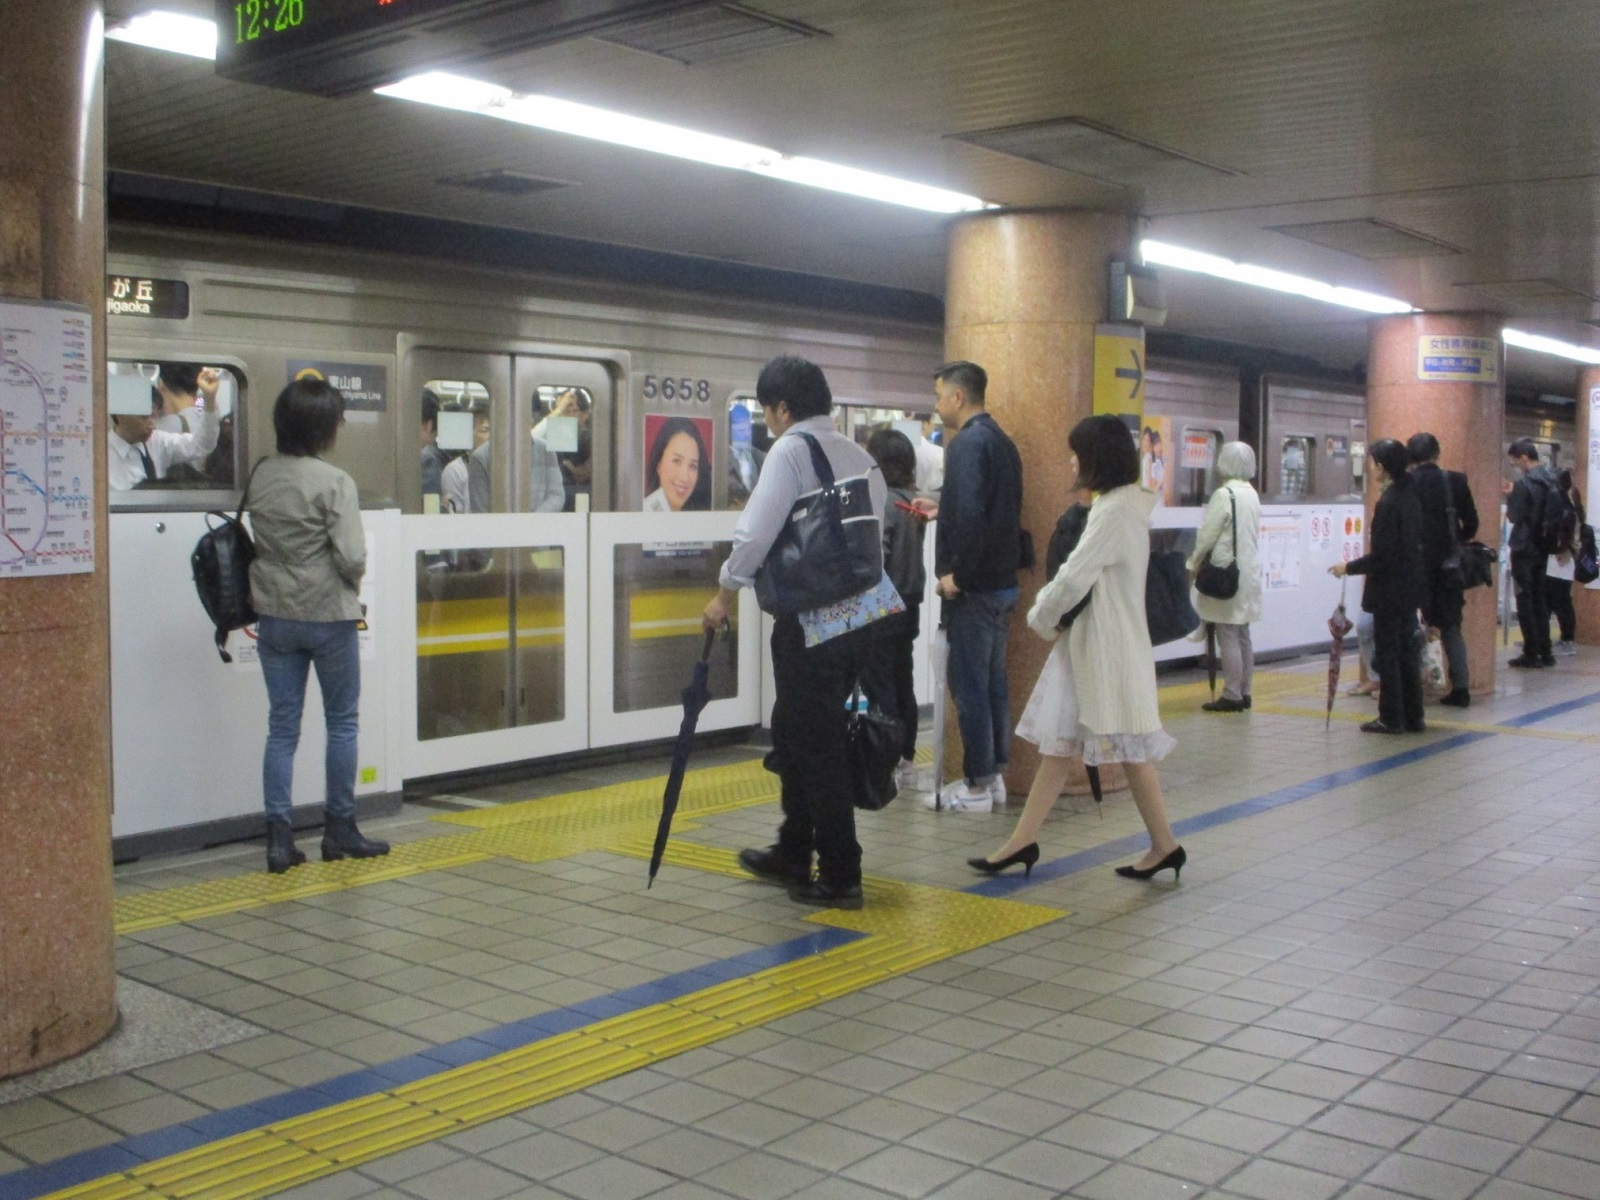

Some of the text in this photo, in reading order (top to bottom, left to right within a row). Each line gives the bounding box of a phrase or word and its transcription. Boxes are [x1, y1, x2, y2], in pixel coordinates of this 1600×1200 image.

[235, 0, 304, 43] 12:26
[113, 278, 153, 301] が丘
[643, 375, 710, 402] 5658
